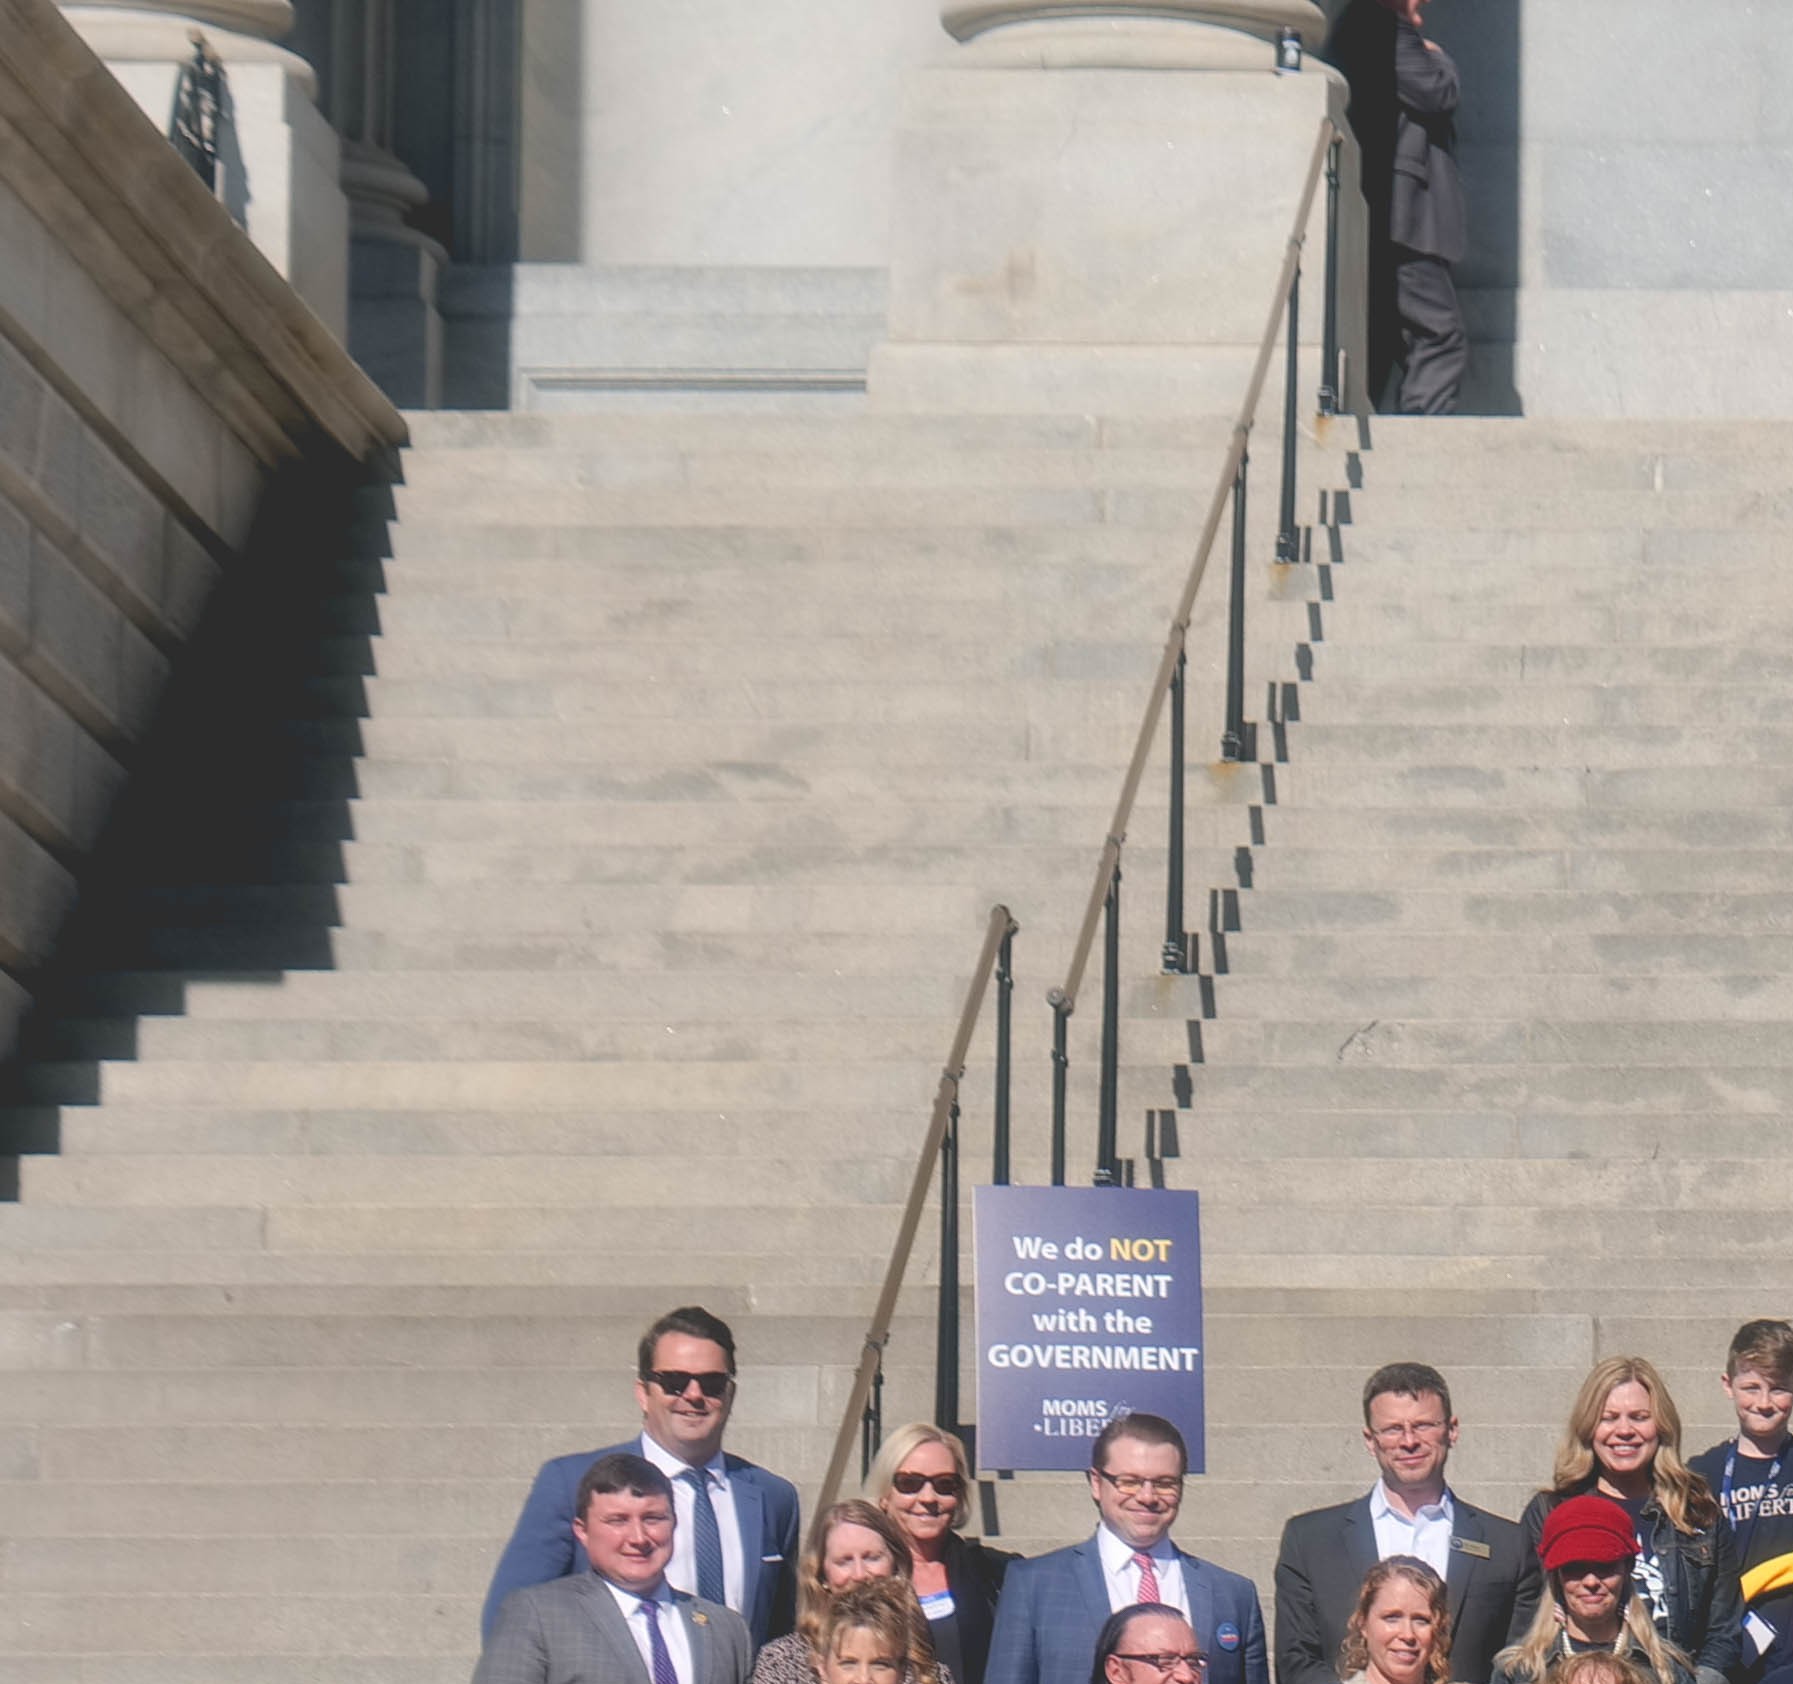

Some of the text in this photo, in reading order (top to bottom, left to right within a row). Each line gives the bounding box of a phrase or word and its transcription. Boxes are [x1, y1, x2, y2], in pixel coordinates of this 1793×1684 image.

[1012, 1236, 1172, 1262] We do NOT
[1005, 1272, 1172, 1298] CO-PARENT
[1033, 1309, 1152, 1334] with the
[988, 1344, 1199, 1372] GOVERNMENT
[1043, 1400, 1107, 1417] MOMS
[1044, 1418, 1112, 1437] LIBE
